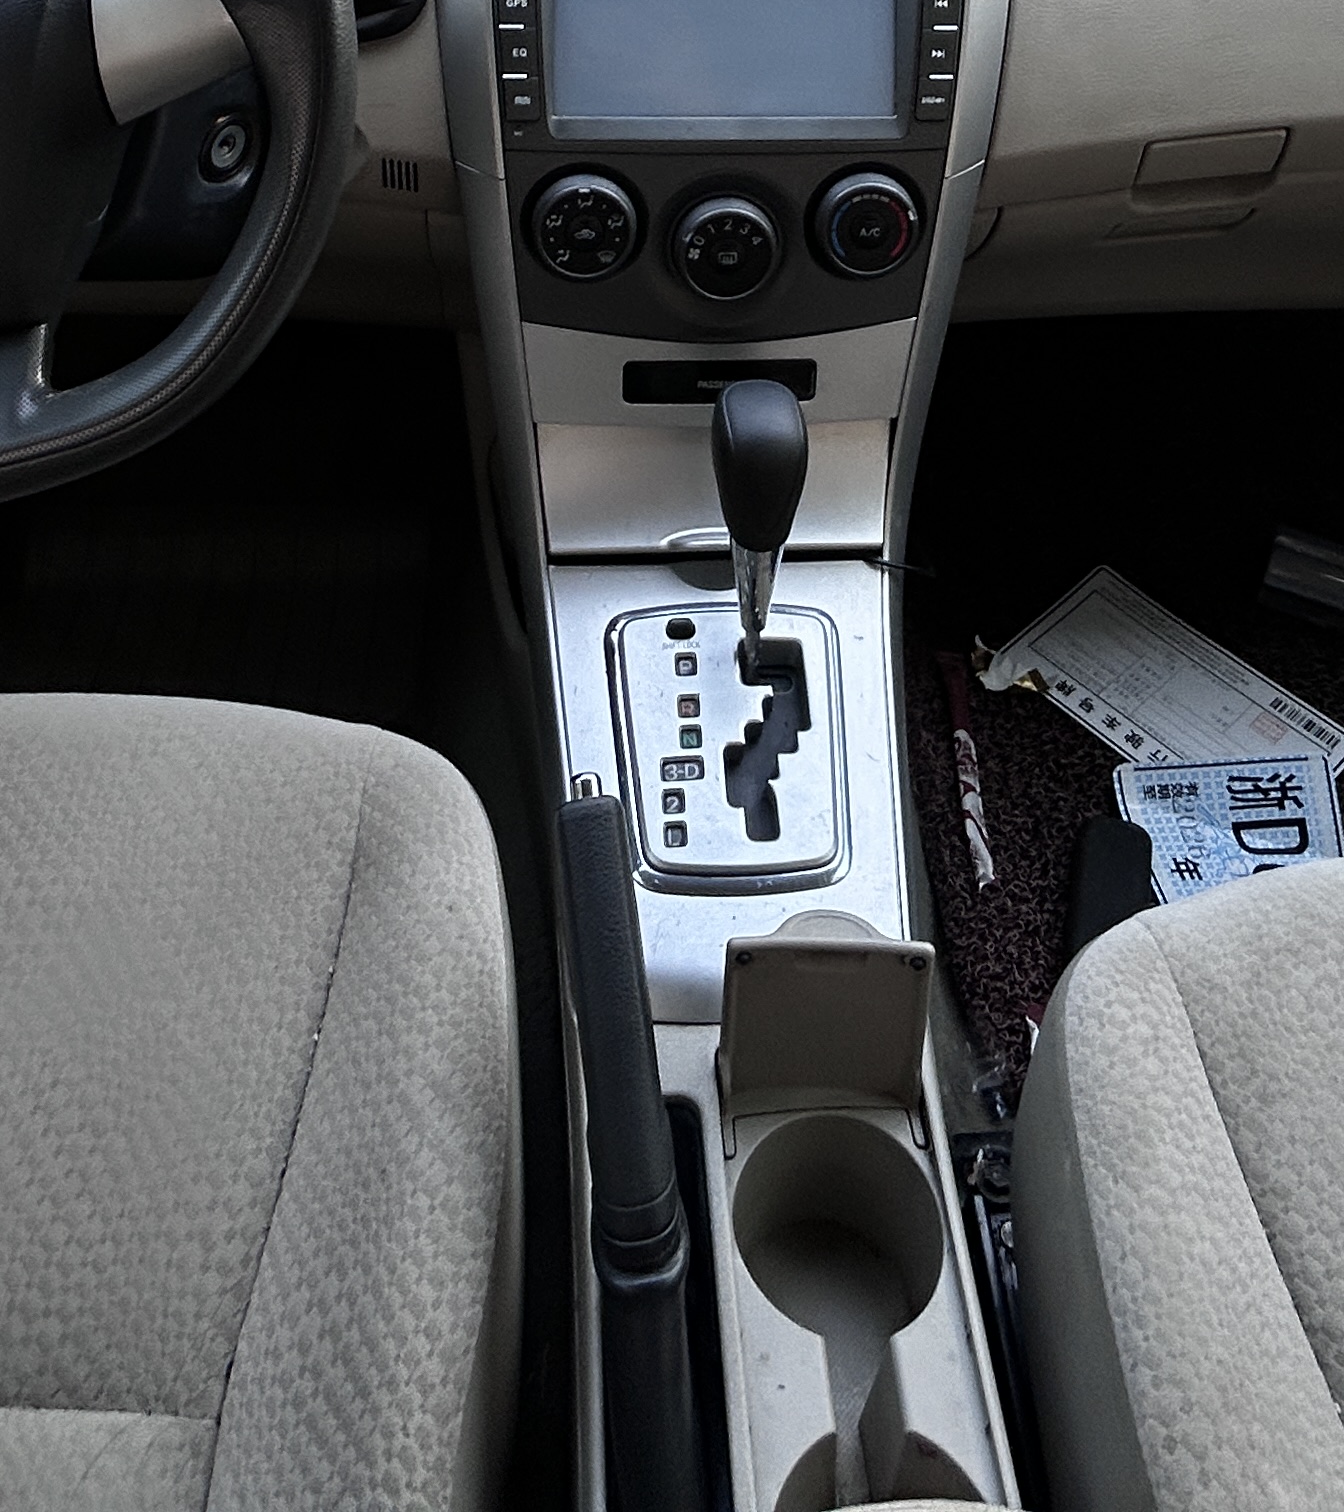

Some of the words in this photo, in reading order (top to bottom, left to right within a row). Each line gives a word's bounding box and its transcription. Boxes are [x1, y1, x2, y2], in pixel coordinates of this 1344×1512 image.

[512, 47, 528, 58] EQ
[724, 219, 734, 231] 2
[740, 223, 752, 235] 3
[859, 226, 882, 238] A/C
[678, 660, 693, 674] P
[681, 702, 695, 716] R
[683, 732, 698, 746] N
[664, 763, 700, 780] 3-D
[1141, 779, 1199, 801] 有效期至
[666, 796, 681, 813] 2
[1225, 771, 1309, 875] 浙D
[1170, 856, 1203, 881] 年
